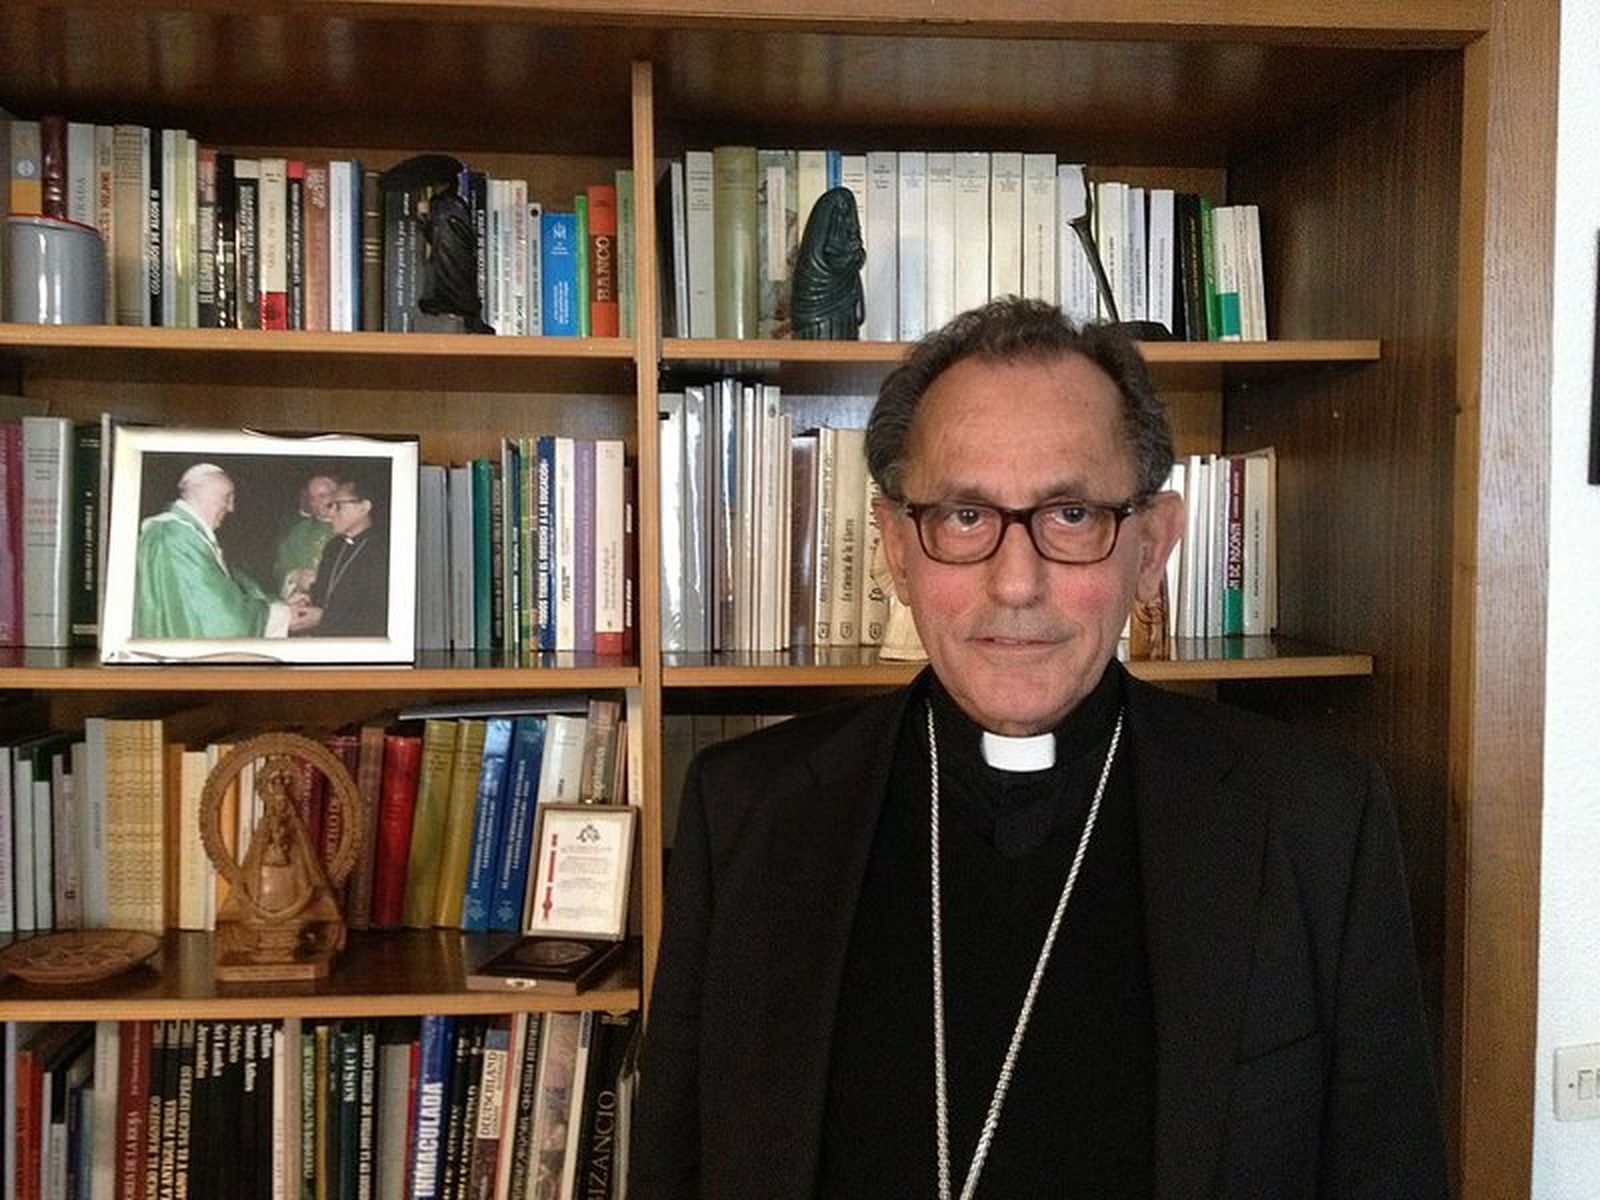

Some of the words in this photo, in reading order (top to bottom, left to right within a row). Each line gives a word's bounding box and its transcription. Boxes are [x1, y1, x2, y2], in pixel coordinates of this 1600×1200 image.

[595, 236, 610, 301] BANCO
[480, 1051, 498, 1136] DEUTSCHLAND
[414, 1081, 444, 1197] INMACULADA
